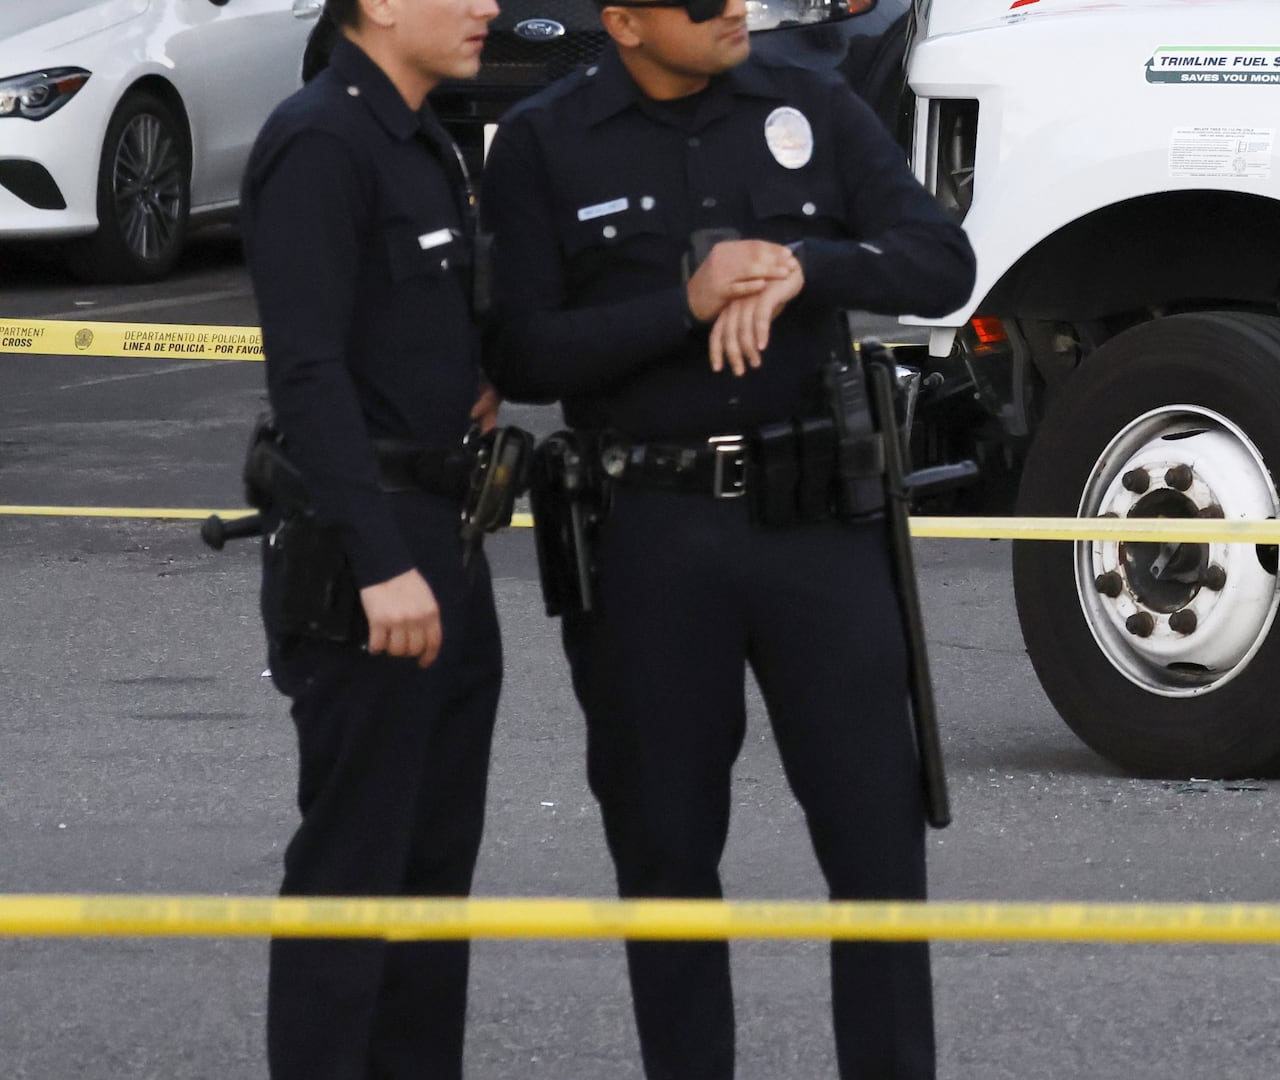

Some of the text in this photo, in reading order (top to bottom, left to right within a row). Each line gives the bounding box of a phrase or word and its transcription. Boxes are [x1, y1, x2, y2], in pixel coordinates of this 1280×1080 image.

[1181, 73, 1219, 82] SAVES
[1222, 74, 1248, 82] YOU
[2, 337, 33, 347] CROSS
[124, 330, 195, 342] DEPARTAMENTO
[197, 332, 210, 342] DE
[211, 333, 246, 344] POLICIA
[123, 342, 151, 351] LINEA
[153, 342, 166, 352] DE
[168, 343, 205, 353] POLICIA
[214, 344, 234, 354] POR
